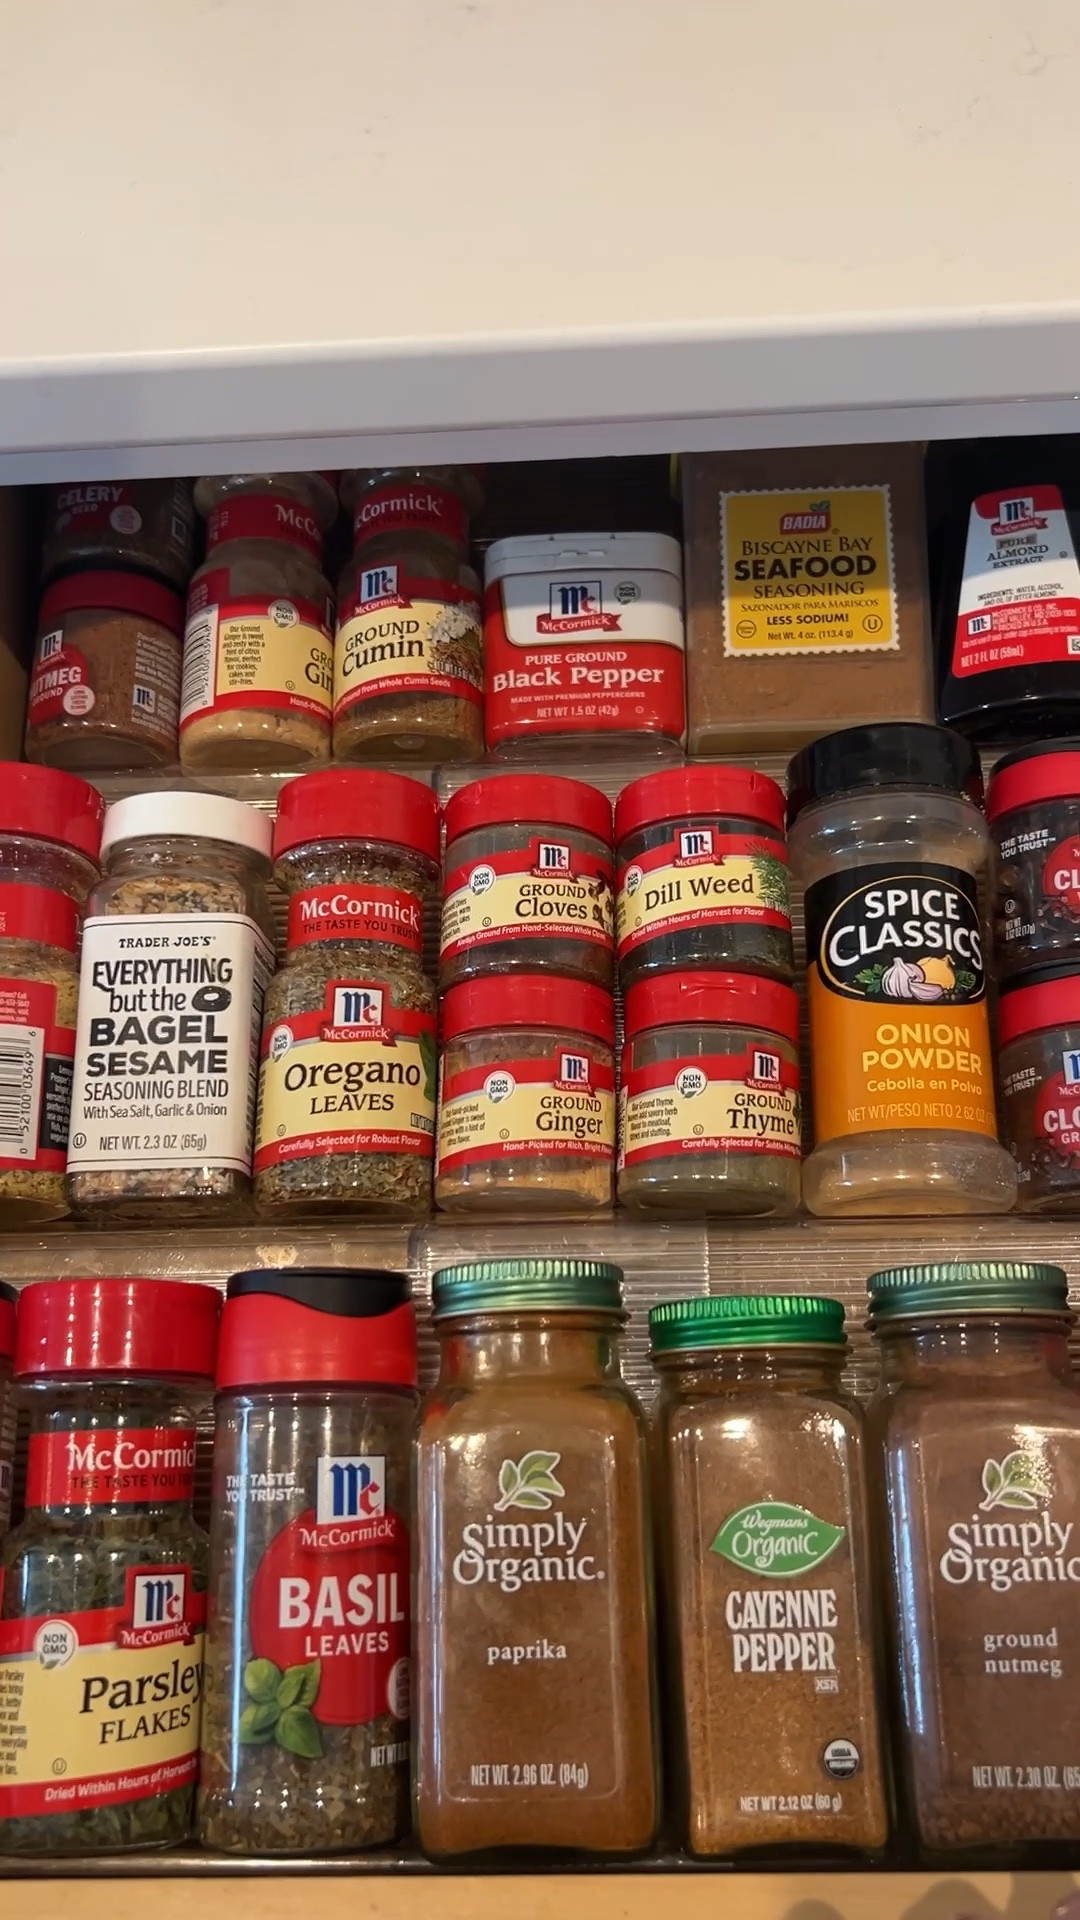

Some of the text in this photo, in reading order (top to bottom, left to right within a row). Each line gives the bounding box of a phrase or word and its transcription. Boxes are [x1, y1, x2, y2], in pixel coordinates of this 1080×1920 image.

[783, 515, 827, 530] BADIA
[742, 536, 873, 556] BISCAYNE BAY
[999, 536, 1035, 548] PURE
[986, 544, 1050, 562] ALMOND
[992, 556, 1045, 569] EXTRACT
[734, 555, 877, 581] SEAFOOD
[754, 581, 864, 599] SEASONING
[355, 594, 405, 614] McCormick
[741, 599, 880, 612] SAZONADOR PARA MARISCOS
[540, 616, 611, 632] McCormick
[766, 613, 850, 626] LESS SODIUM!
[345, 620, 420, 651] GROUND
[767, 632, 782, 640] Net
[343, 634, 424, 677] Cumin
[525, 651, 627, 666] PURE GROUND
[380, 675, 429, 689] Whole Cumin
[493, 667, 562, 692] Black
[571, 667, 664, 688] Pepper
[511, 691, 645, 704] MADE WITH PREMIUM PEPPERCORNS
[1000, 829, 1049, 850] THE TASTE
[1001, 847, 1017, 859] YOU
[474, 872, 489, 881] NON
[474, 879, 490, 888] GMO
[688, 874, 755, 897] Weed
[519, 884, 587, 899] GROUND
[645, 881, 682, 911] Dill
[300, 895, 419, 931] McCormick
[515, 898, 588, 919] Cloves
[864, 889, 960, 920] SPICE
[303, 919, 388, 935] THE TASTE YOU
[668, 907, 765, 926] Hours Harvest for Flavor
[119, 936, 212, 950] TRADER JOE'S
[478, 924, 573, 943] Ground From Hand-Selected
[829, 920, 983, 970] CLASSICS
[92, 958, 233, 992] EVERYTHING
[109, 986, 187, 1013] but the
[90, 1015, 228, 1047] BAGEL
[323, 1028, 388, 1046] McCormick
[876, 1024, 971, 1048] ONION
[86, 1050, 228, 1077] SESAME
[862, 1048, 983, 1076] POWDER
[284, 1061, 420, 1092] Oregano
[490, 1079, 508, 1087] NON
[682, 1074, 701, 1082] NON
[682, 1081, 701, 1089] GMO
[867, 1078, 983, 1096] Cebolla en Polvo
[19, 1052, 35, 1132] 52100 03649
[84, 1080, 229, 1101] SEASONING BLEND
[83, 1102, 228, 1120] With Sea Salt, Garlic & Onion
[310, 1094, 395, 1115] LEAVES
[540, 1096, 602, 1113] GROUND
[734, 1093, 792, 1113] GROUND
[847, 1107, 866, 1124] NET
[868, 1102, 921, 1121] WT/PESO
[924, 1102, 953, 1119] NETO
[955, 1104, 975, 1120] 2.62
[536, 1110, 604, 1139] Ginger
[726, 1107, 795, 1137] Thyme
[99, 1133, 208, 1151] NET WT. 2.3 OZ (65g)
[278, 1133, 400, 1154] Carefully Selected for Robust
[503, 1140, 566, 1152] Hand-Picked for
[682, 1138, 765, 1151] Carefully Selected for
[66, 1441, 195, 1470] McCormic
[72, 1473, 175, 1489] THE TASTE YOU
[250, 1472, 296, 1487] TASTE
[300, 1519, 394, 1548] McCormick
[740, 1510, 809, 1536] Wegmans
[946, 1511, 1074, 1556] Simply
[463, 1512, 588, 1558] Simply
[731, 1530, 819, 1567] Organic
[939, 1548, 1080, 1592] Organic
[279, 1573, 404, 1629] BASIL
[725, 1589, 838, 1630] CAYENNE
[44, 1634, 67, 1643] NON
[122, 1623, 190, 1646] McCormick
[305, 1631, 390, 1657] LEAVES
[983, 1627, 1058, 1652] ground
[43, 1643, 67, 1654] GMO
[487, 1637, 567, 1664] paprika
[732, 1631, 837, 1673] PEPPER
[984, 1659, 1062, 1678] nutmeg
[79, 1658, 201, 1714] Parsley
[99, 1704, 191, 1744] FLAKES
[45, 1769, 163, 1801] Dried Within Hours of
[471, 1762, 589, 1789] NET WT. 2.96 (84g)
[972, 1765, 1041, 1788] NET 2.30
[740, 1794, 813, 1811] NET WT 2.12 OZ
